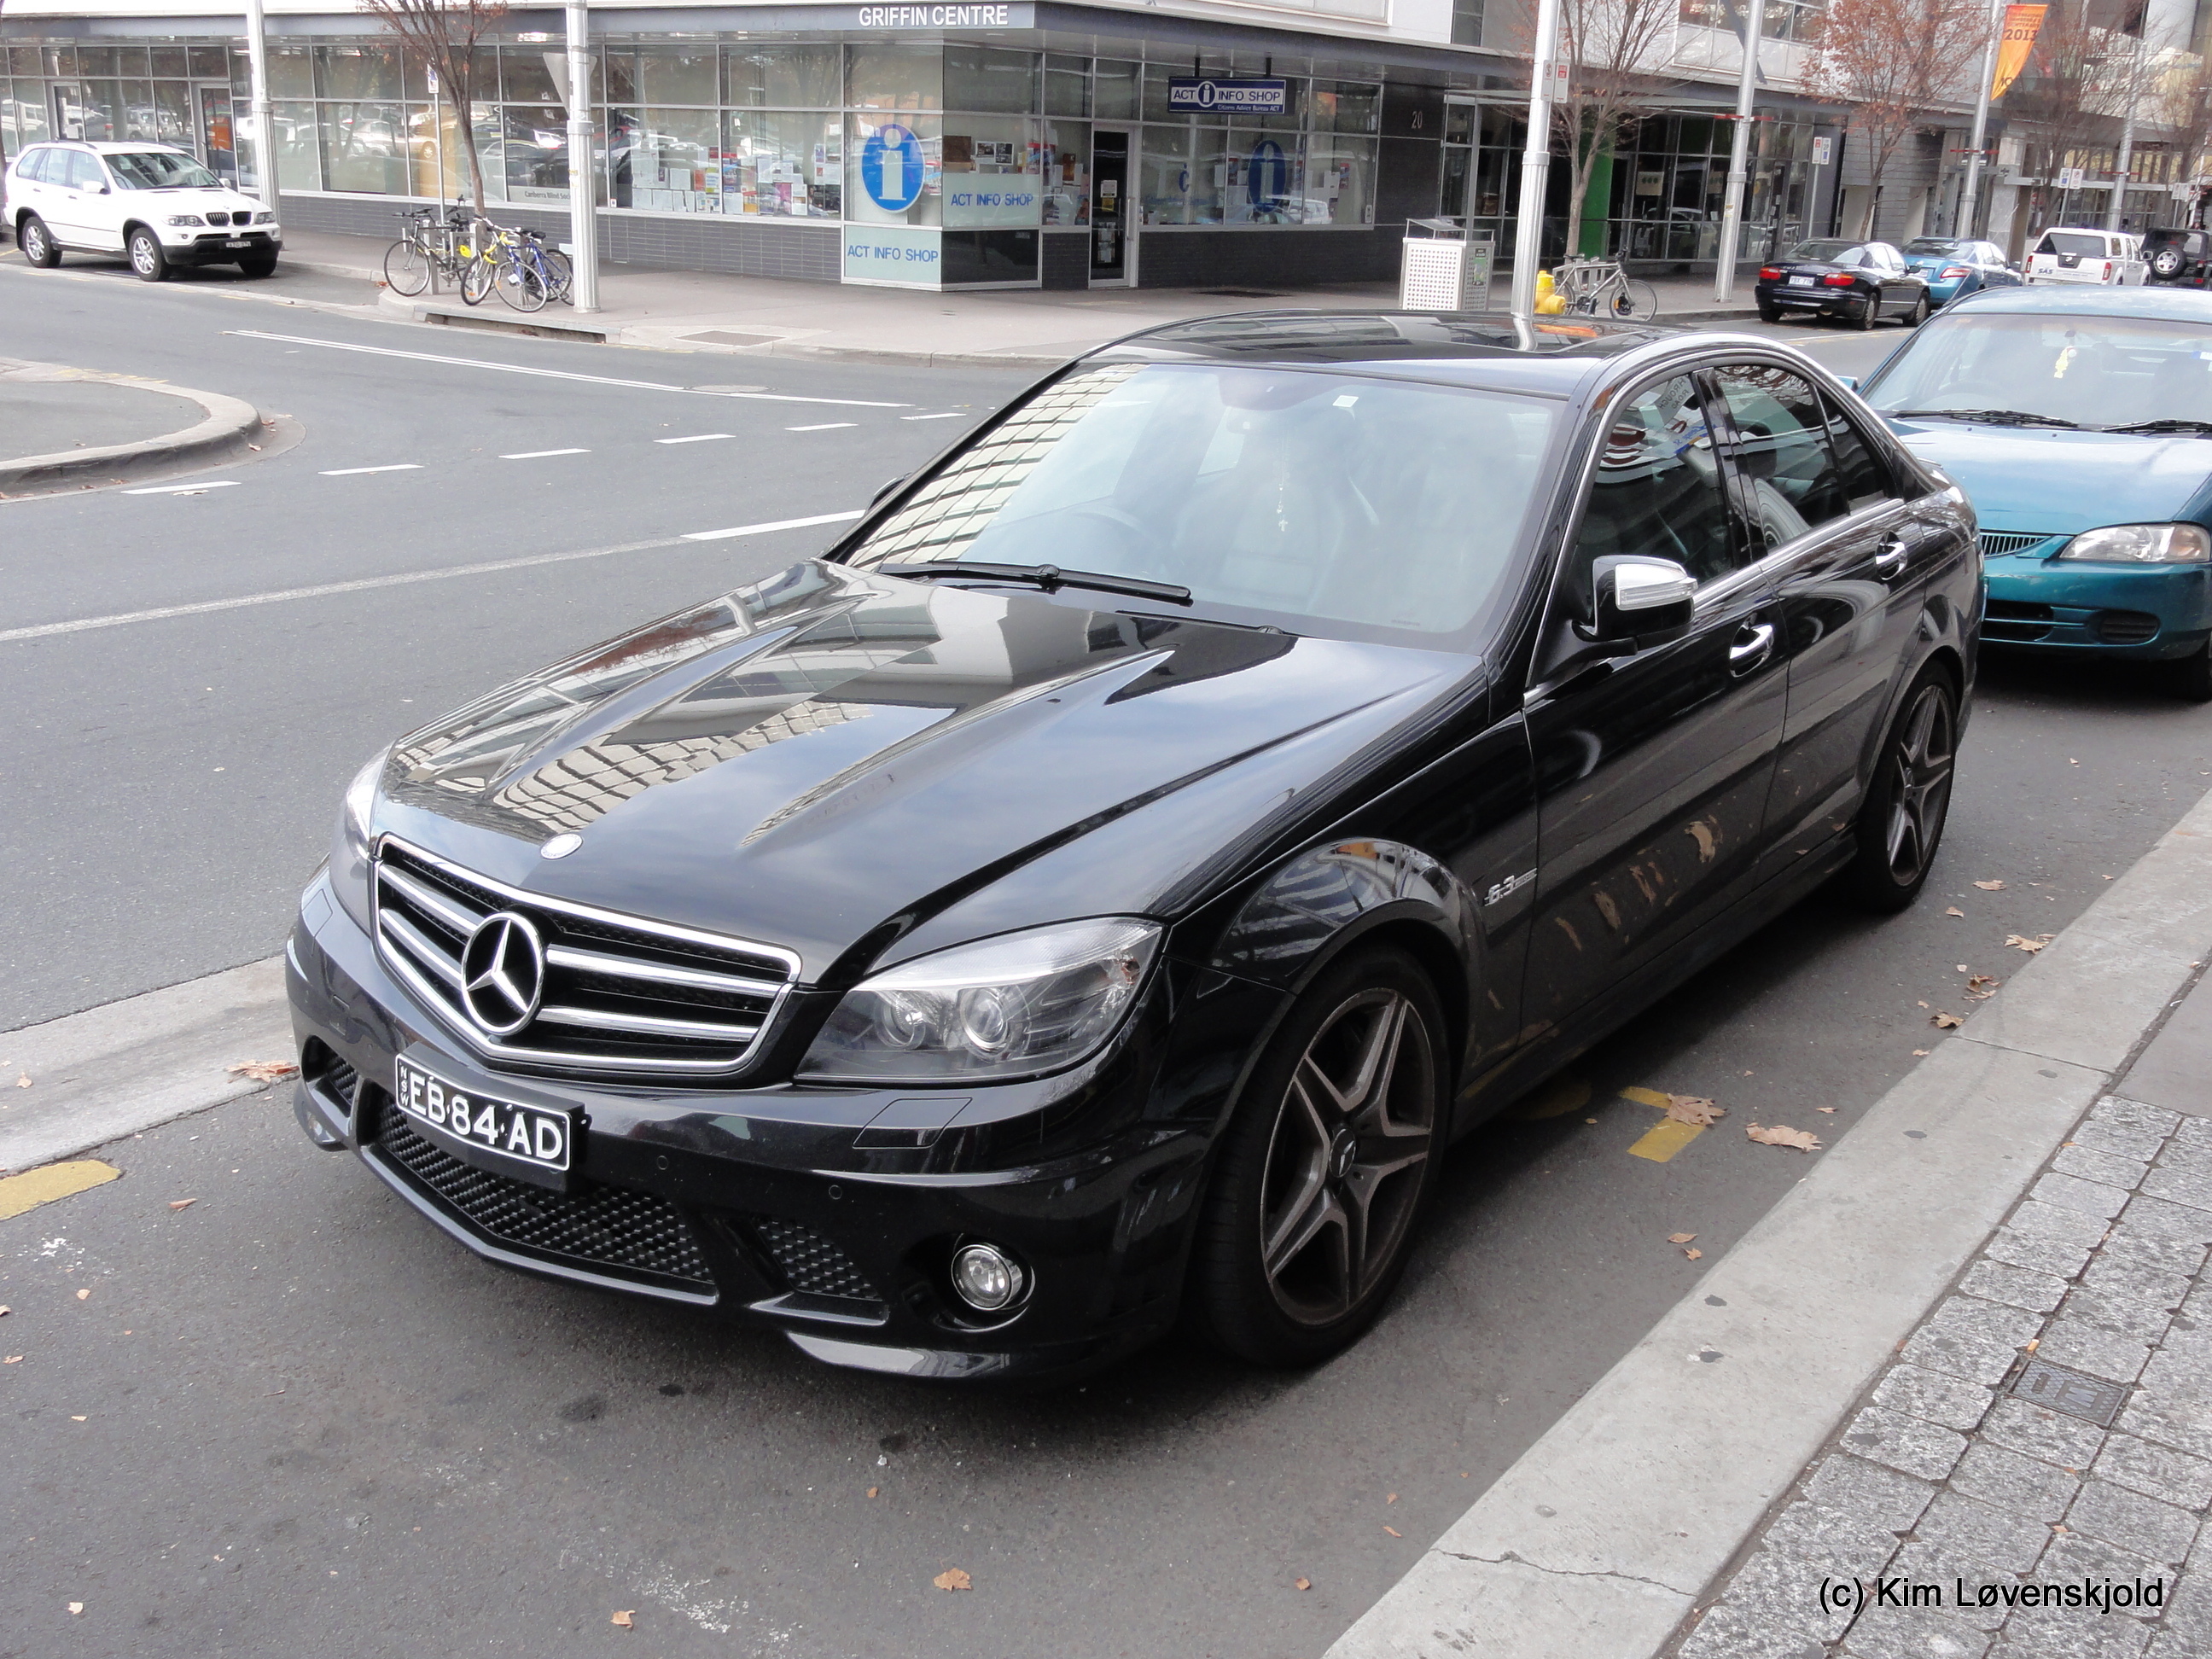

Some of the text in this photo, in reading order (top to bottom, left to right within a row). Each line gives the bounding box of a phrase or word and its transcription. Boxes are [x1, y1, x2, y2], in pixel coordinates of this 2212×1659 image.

[859, 4, 1009, 26] GRIFFIN CENTRE
[2005, 28, 2038, 41] 2013
[1173, 89, 1196, 100] ACT
[1218, 90, 1244, 101] INFO
[1249, 90, 1280, 102] SHOP
[1411, 110, 1423, 129] 20
[525, 190, 546, 199] Canberra
[951, 193, 1033, 207] ACT INFO SHOP
[847, 245, 939, 262] ACT INFO SHOP
[399, 1066, 410, 1107] NSW
